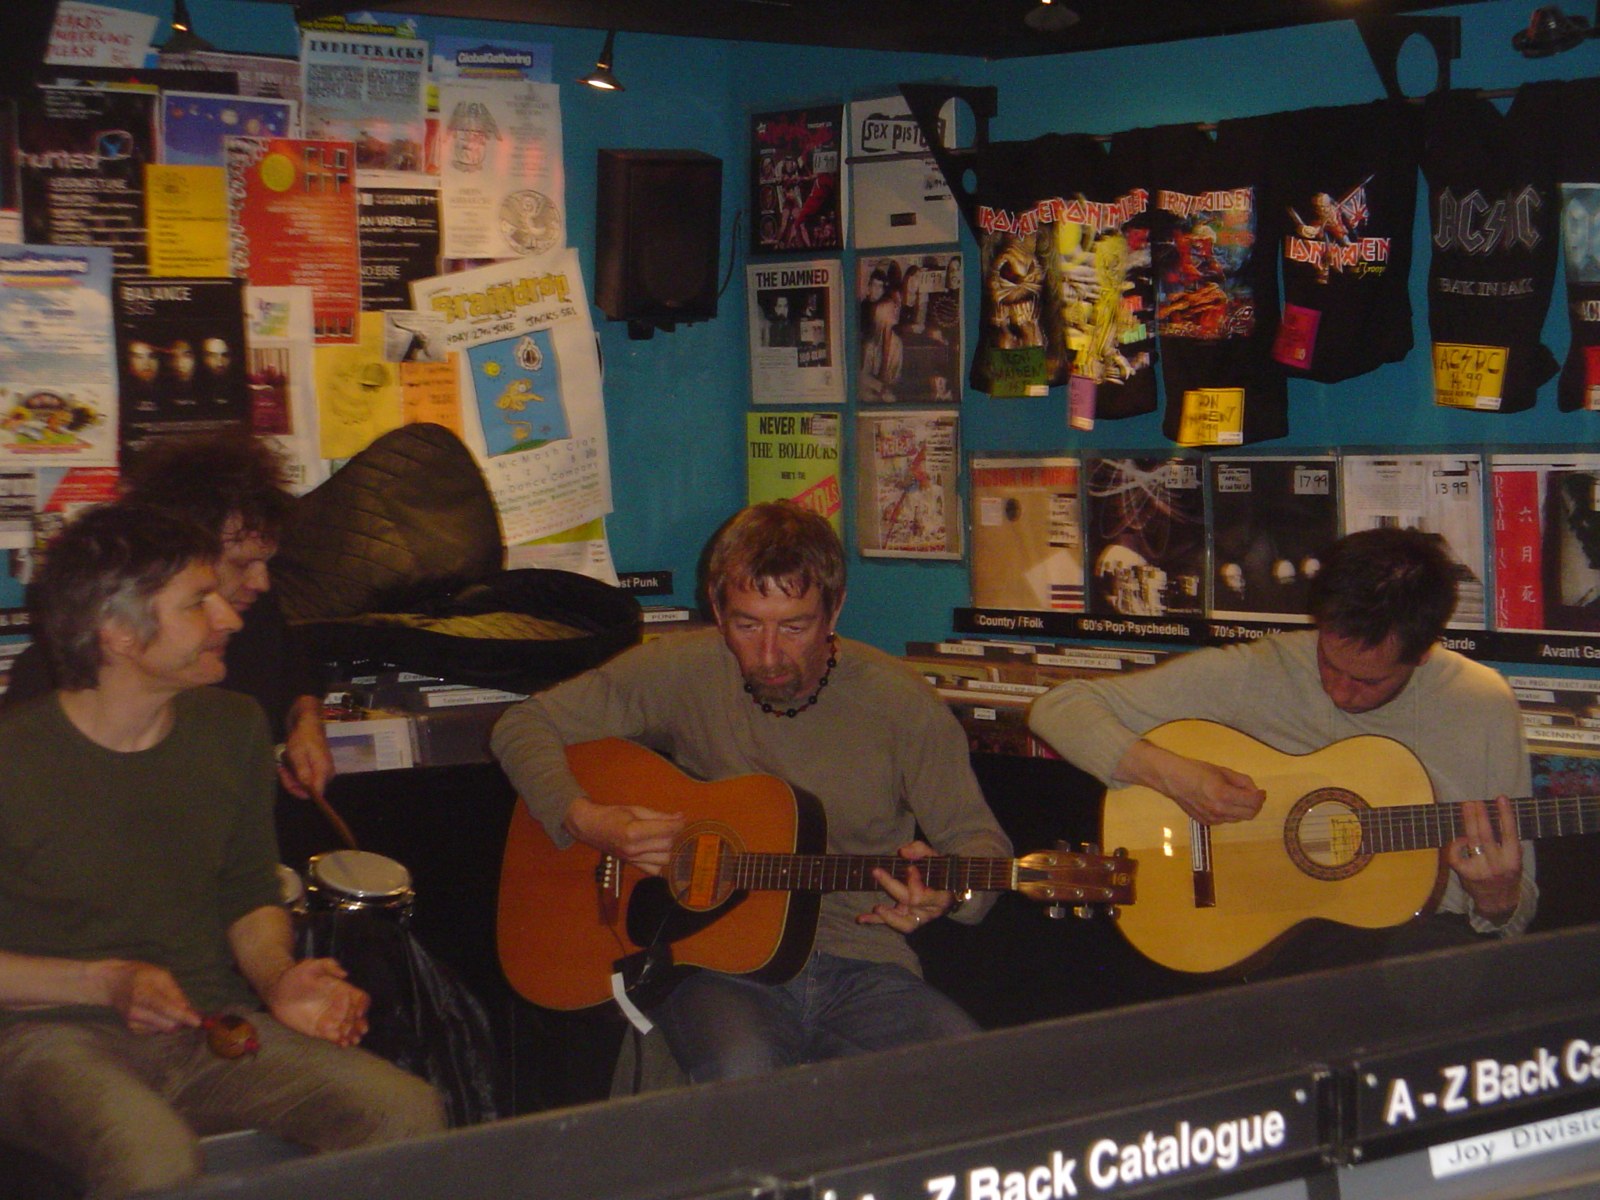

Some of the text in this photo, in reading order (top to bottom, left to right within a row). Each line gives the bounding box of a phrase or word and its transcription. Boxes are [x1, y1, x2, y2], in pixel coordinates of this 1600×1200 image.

[310, 40, 424, 59] INDIETRACKS
[458, 52, 531, 66] GlobalGathering
[756, 269, 829, 287] THE DAMNED
[759, 416, 795, 434] NEVER
[750, 442, 838, 459] THE BOLLOCKS
[633, 577, 658, 588] Punk
[979, 614, 1015, 630] Country
[1024, 616, 1044, 629] Folk
[1083, 619, 1190, 637] 60's Pop Psychedelia
[1543, 644, 1580, 659] Avant
[1474, 1047, 1559, 1104] Back
[967, 1151, 1077, 1200] Back
[1088, 1110, 1286, 1189] Catalogue
[1448, 1142, 1496, 1165] Joy
